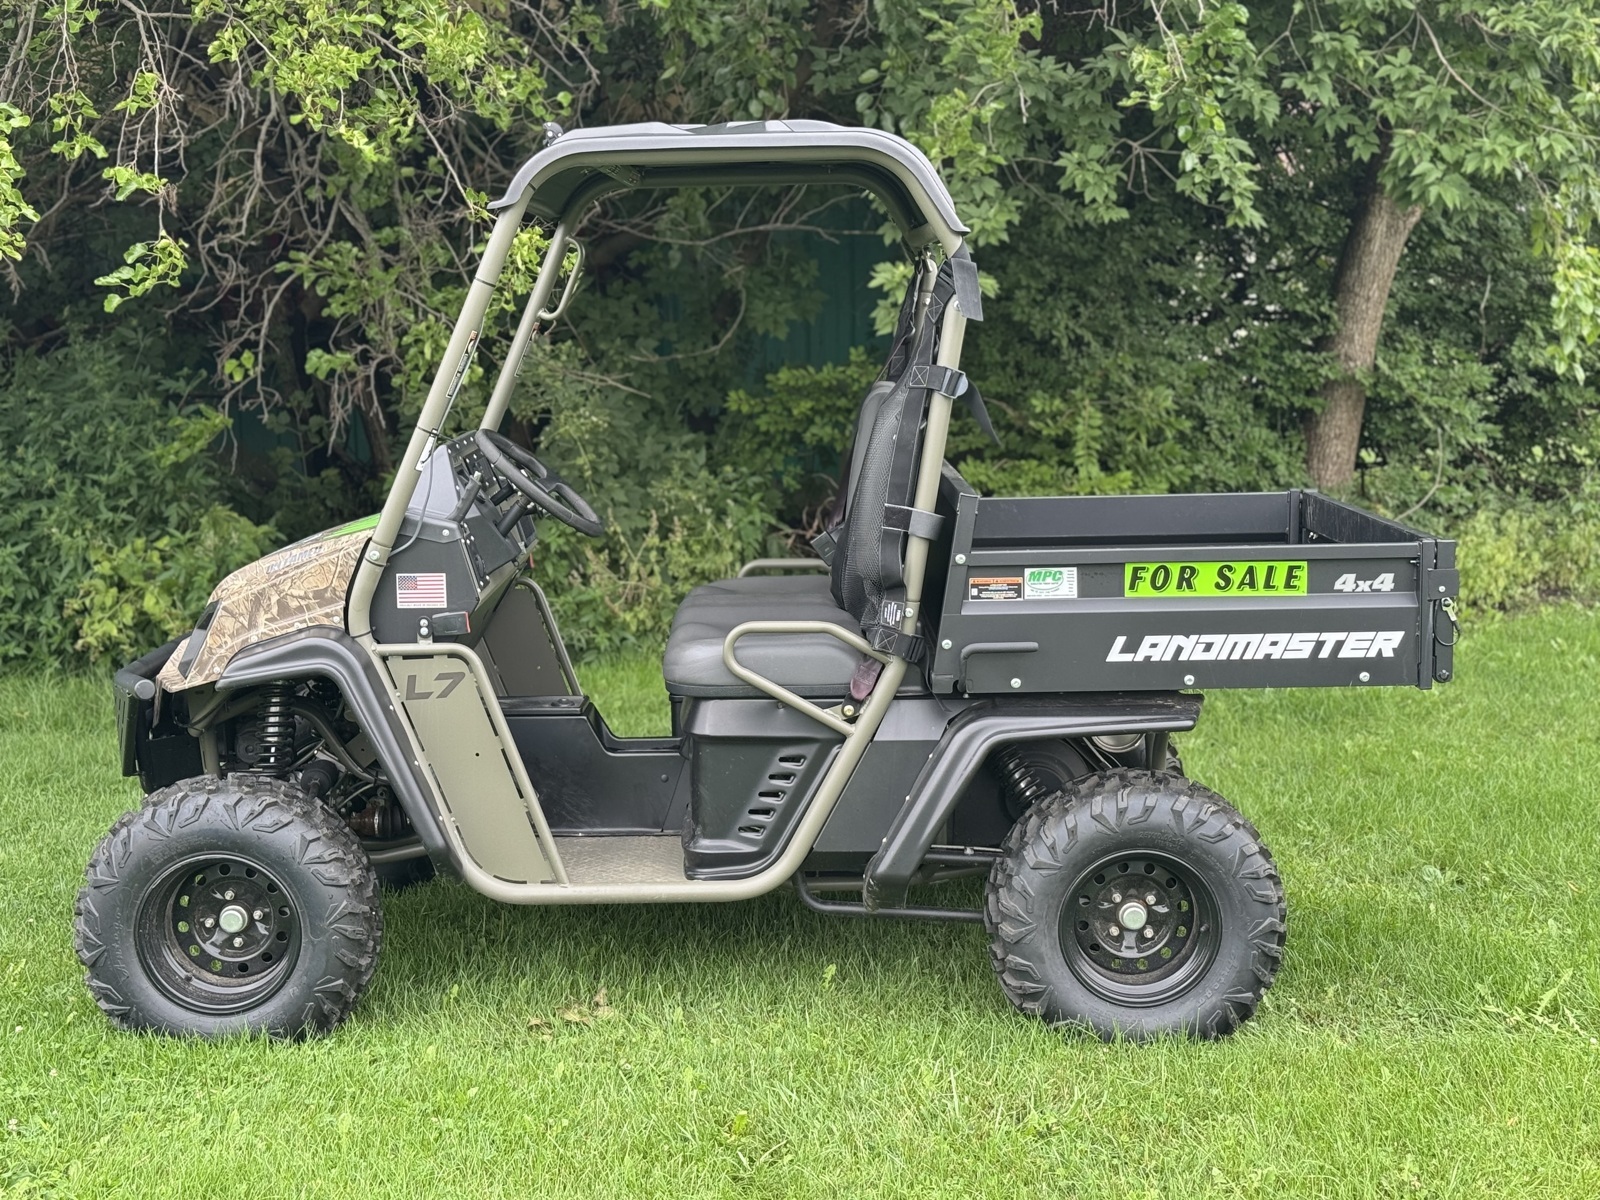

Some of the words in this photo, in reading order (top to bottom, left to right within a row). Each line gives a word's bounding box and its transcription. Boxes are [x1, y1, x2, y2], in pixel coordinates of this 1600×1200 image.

[1027, 570, 1063, 582] MPC
[1128, 564, 1199, 592] FOR
[1214, 564, 1305, 591] SALE
[1333, 573, 1395, 592] 4x4
[1105, 631, 1405, 662] LANDMASTER
[405, 671, 466, 701] L7
